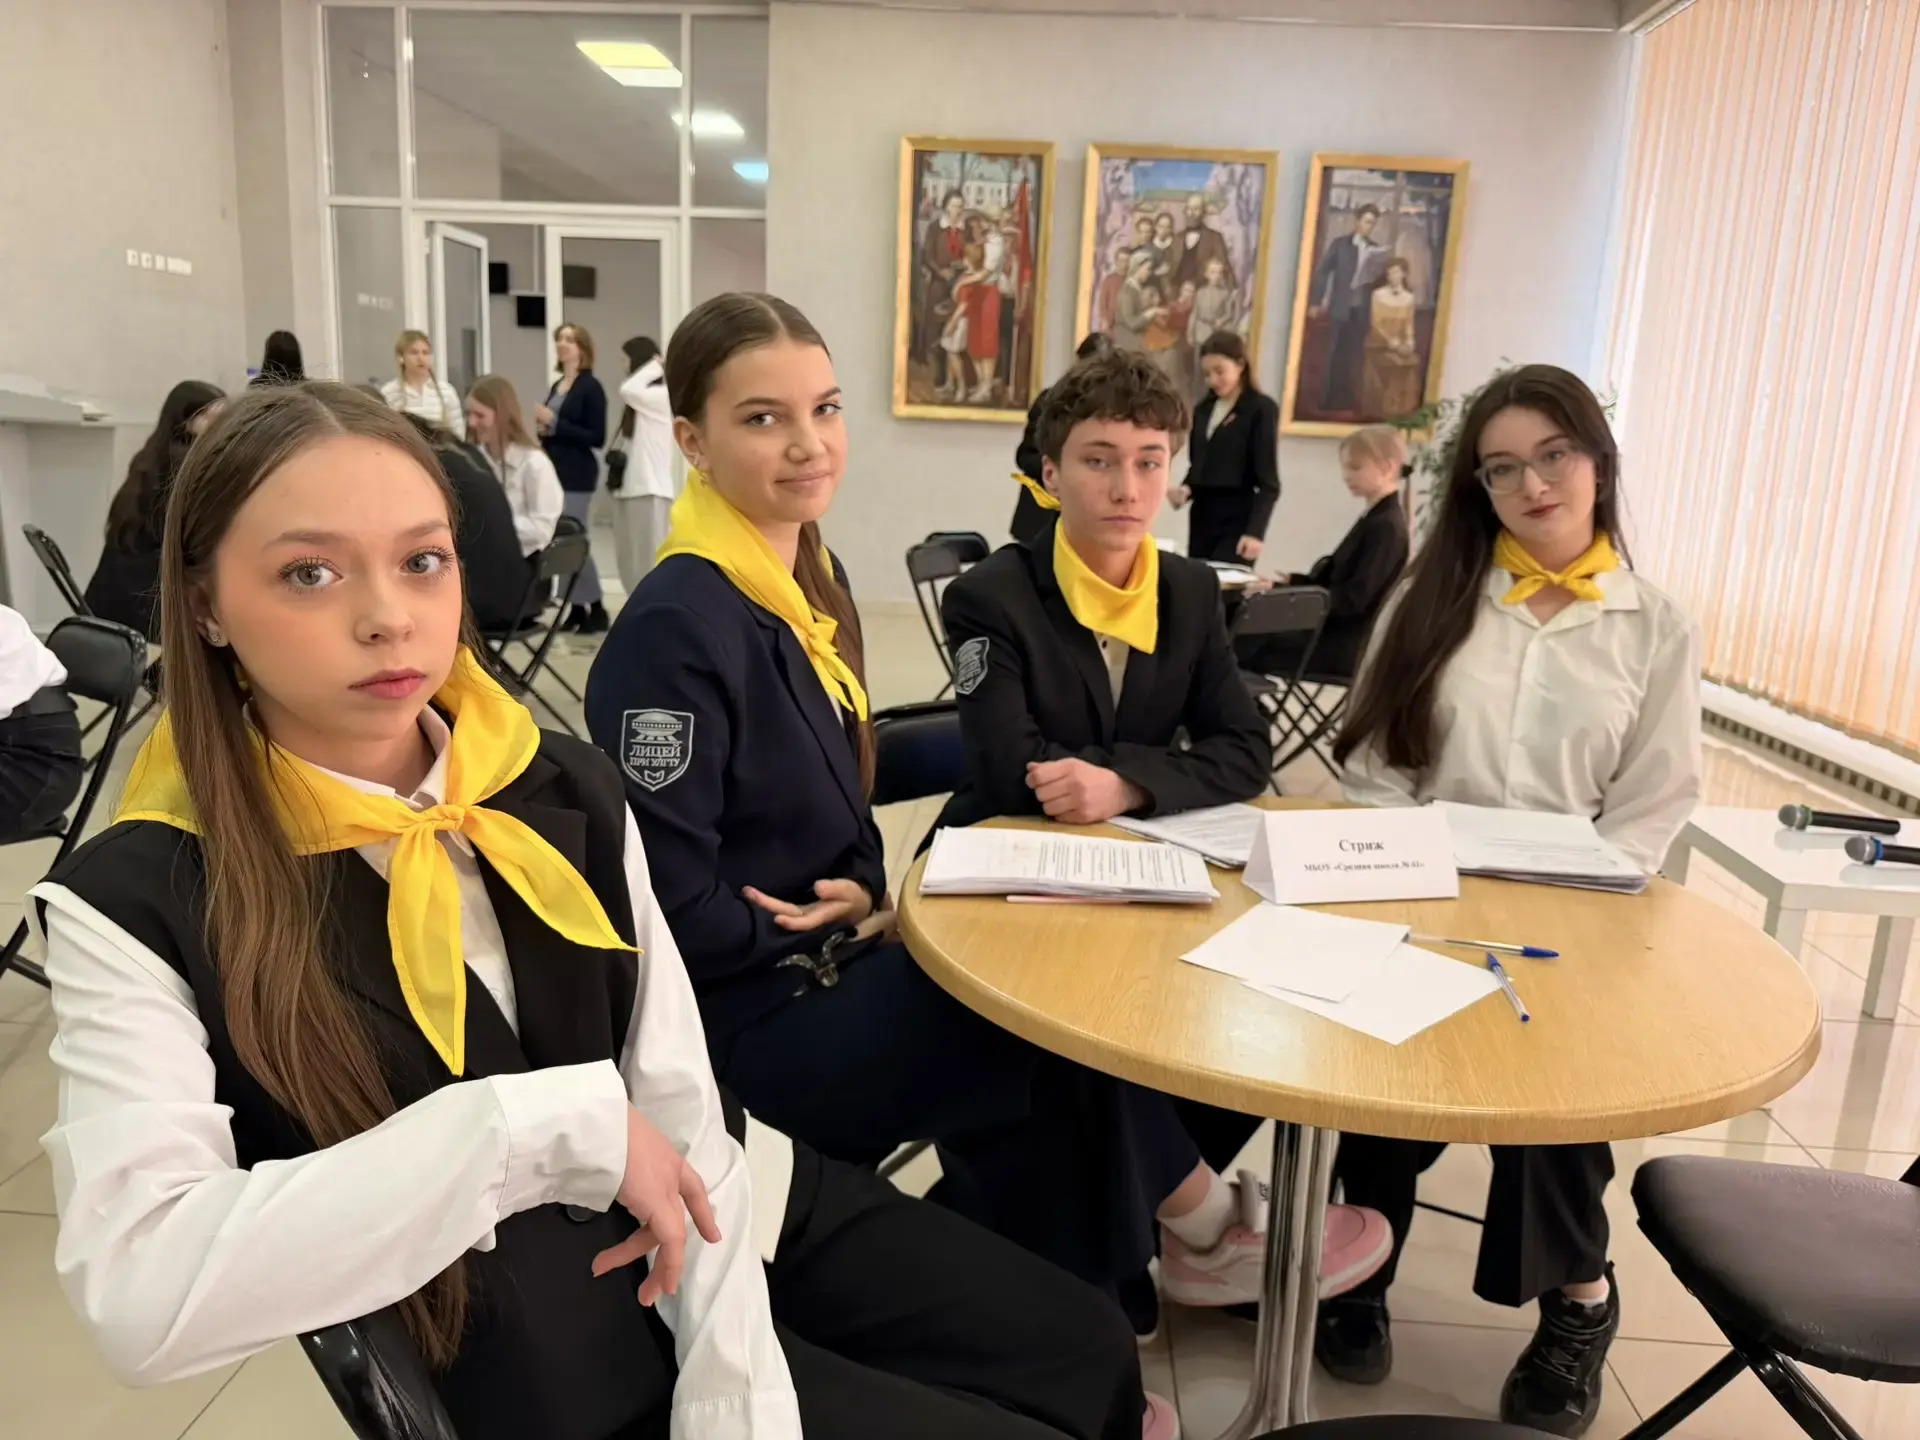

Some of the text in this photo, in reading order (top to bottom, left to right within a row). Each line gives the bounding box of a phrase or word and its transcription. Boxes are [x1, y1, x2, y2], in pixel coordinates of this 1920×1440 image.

[629, 743, 681, 758] ЛИЦЕЙ
[629, 757, 650, 766] ПРИ
[1338, 838, 1385, 854] Стриж
